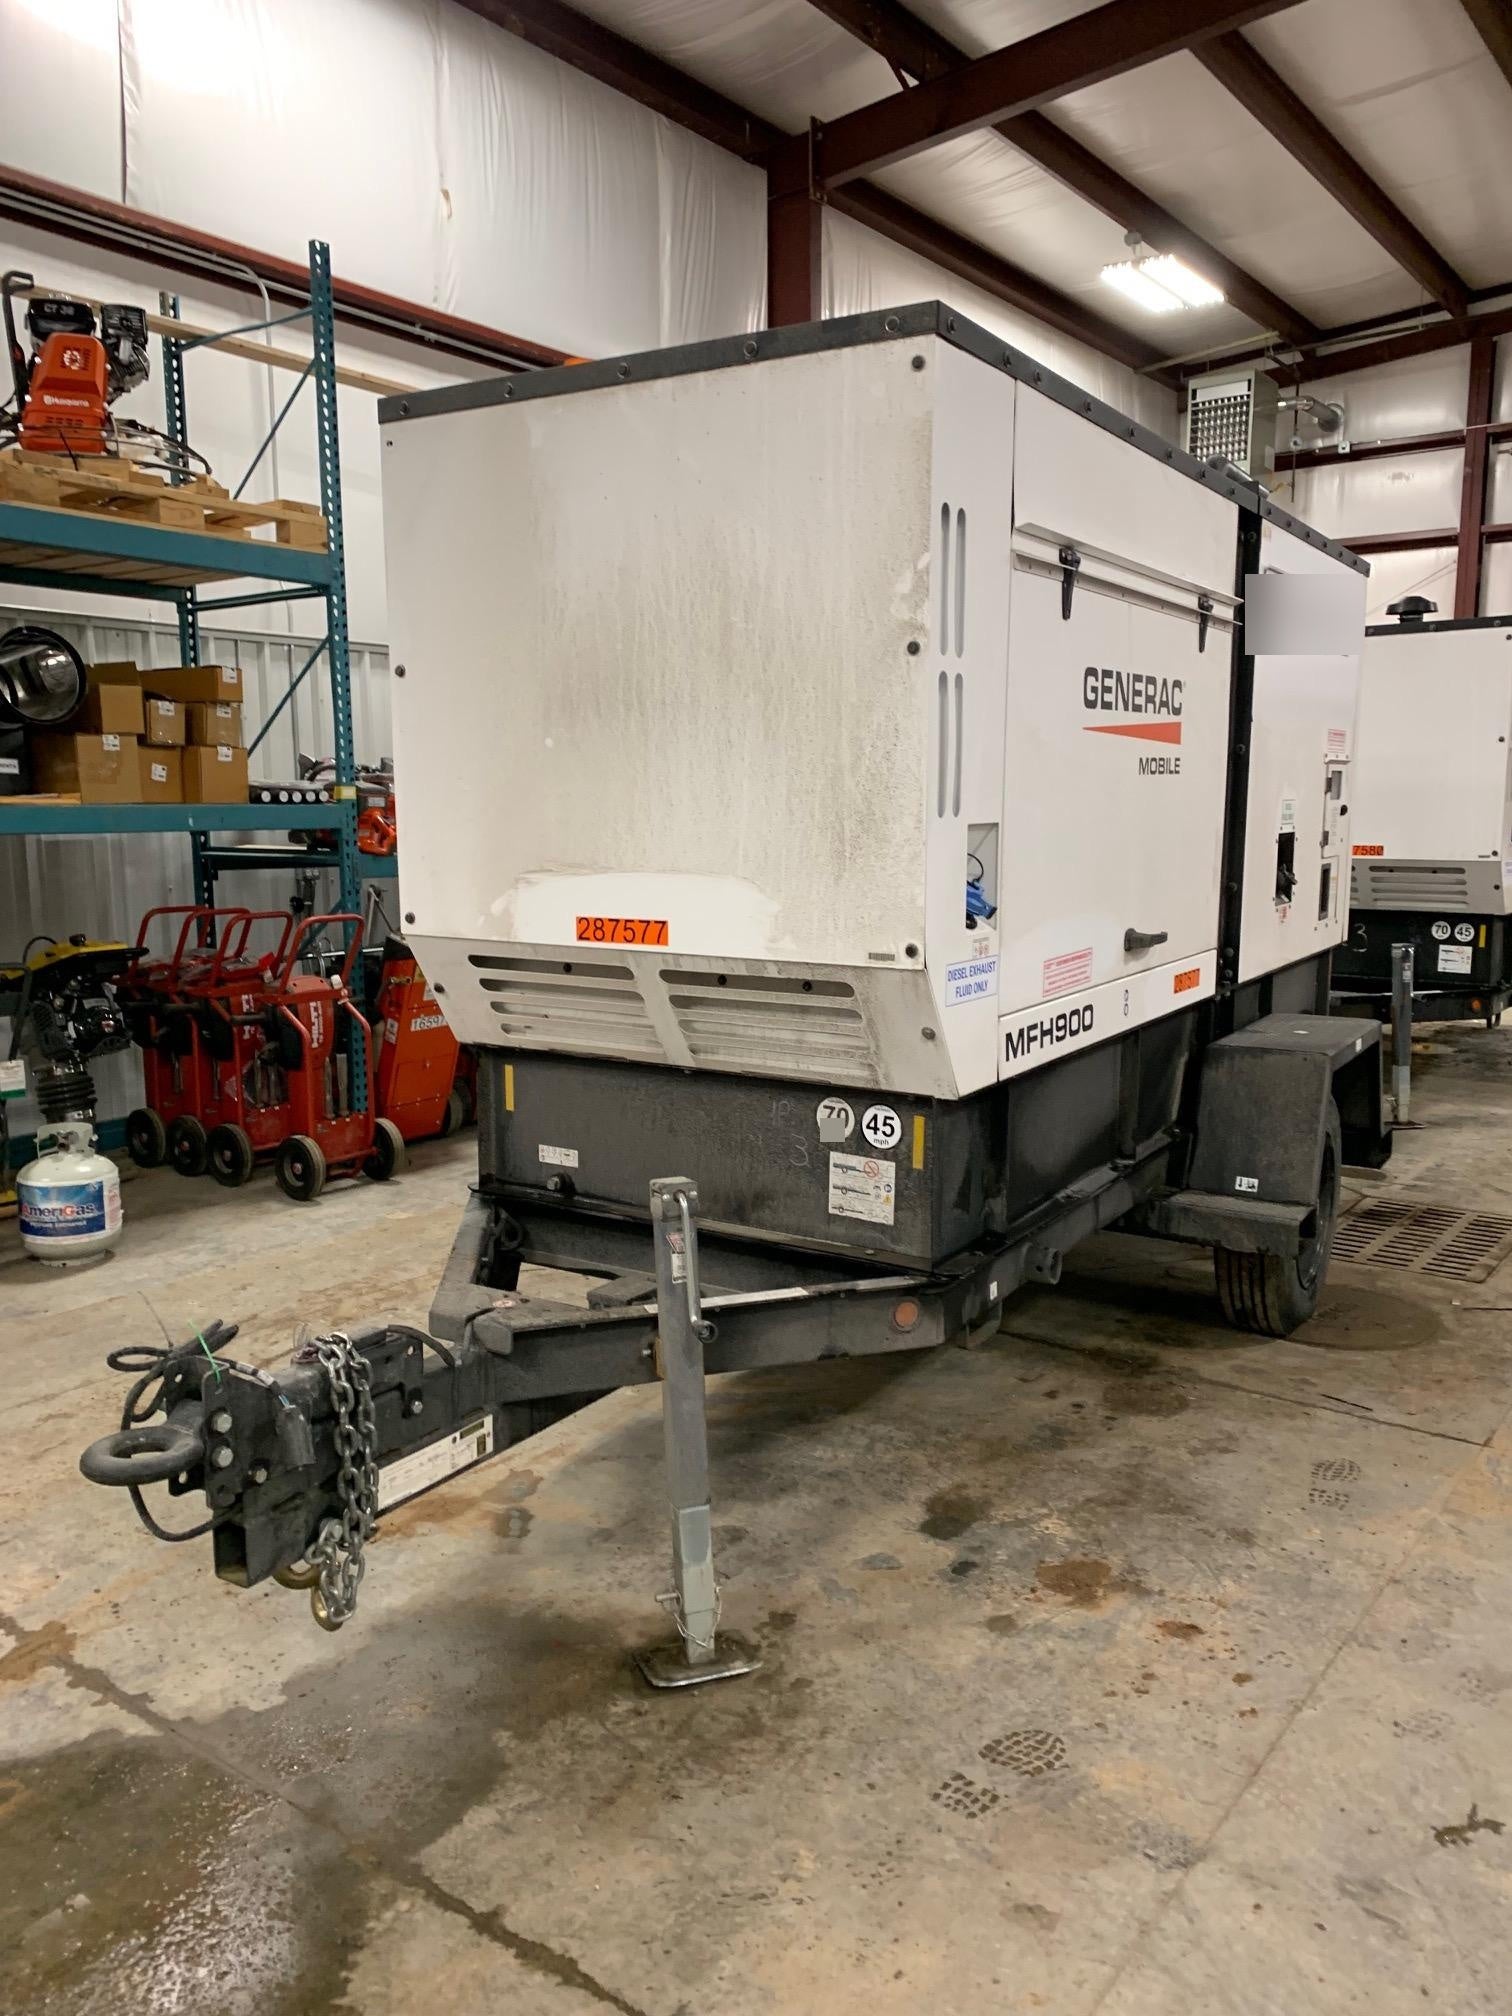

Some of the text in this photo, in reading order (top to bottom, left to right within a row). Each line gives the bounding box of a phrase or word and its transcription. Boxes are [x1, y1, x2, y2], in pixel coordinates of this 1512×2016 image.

[1083, 666, 1183, 716] GENERAC
[1138, 757, 1181, 775] MOBILE
[578, 917, 667, 943] 287577
[1435, 924, 1448, 935] 70
[1457, 926, 1471, 937] 45
[947, 960, 996, 982] DIESEL EXHAUST
[955, 980, 989, 998] FLUID ONLY
[1005, 1003, 1094, 1062] MFH900
[865, 1113, 895, 1138] 45
[20, 1202, 95, 1218] AmeriGas
